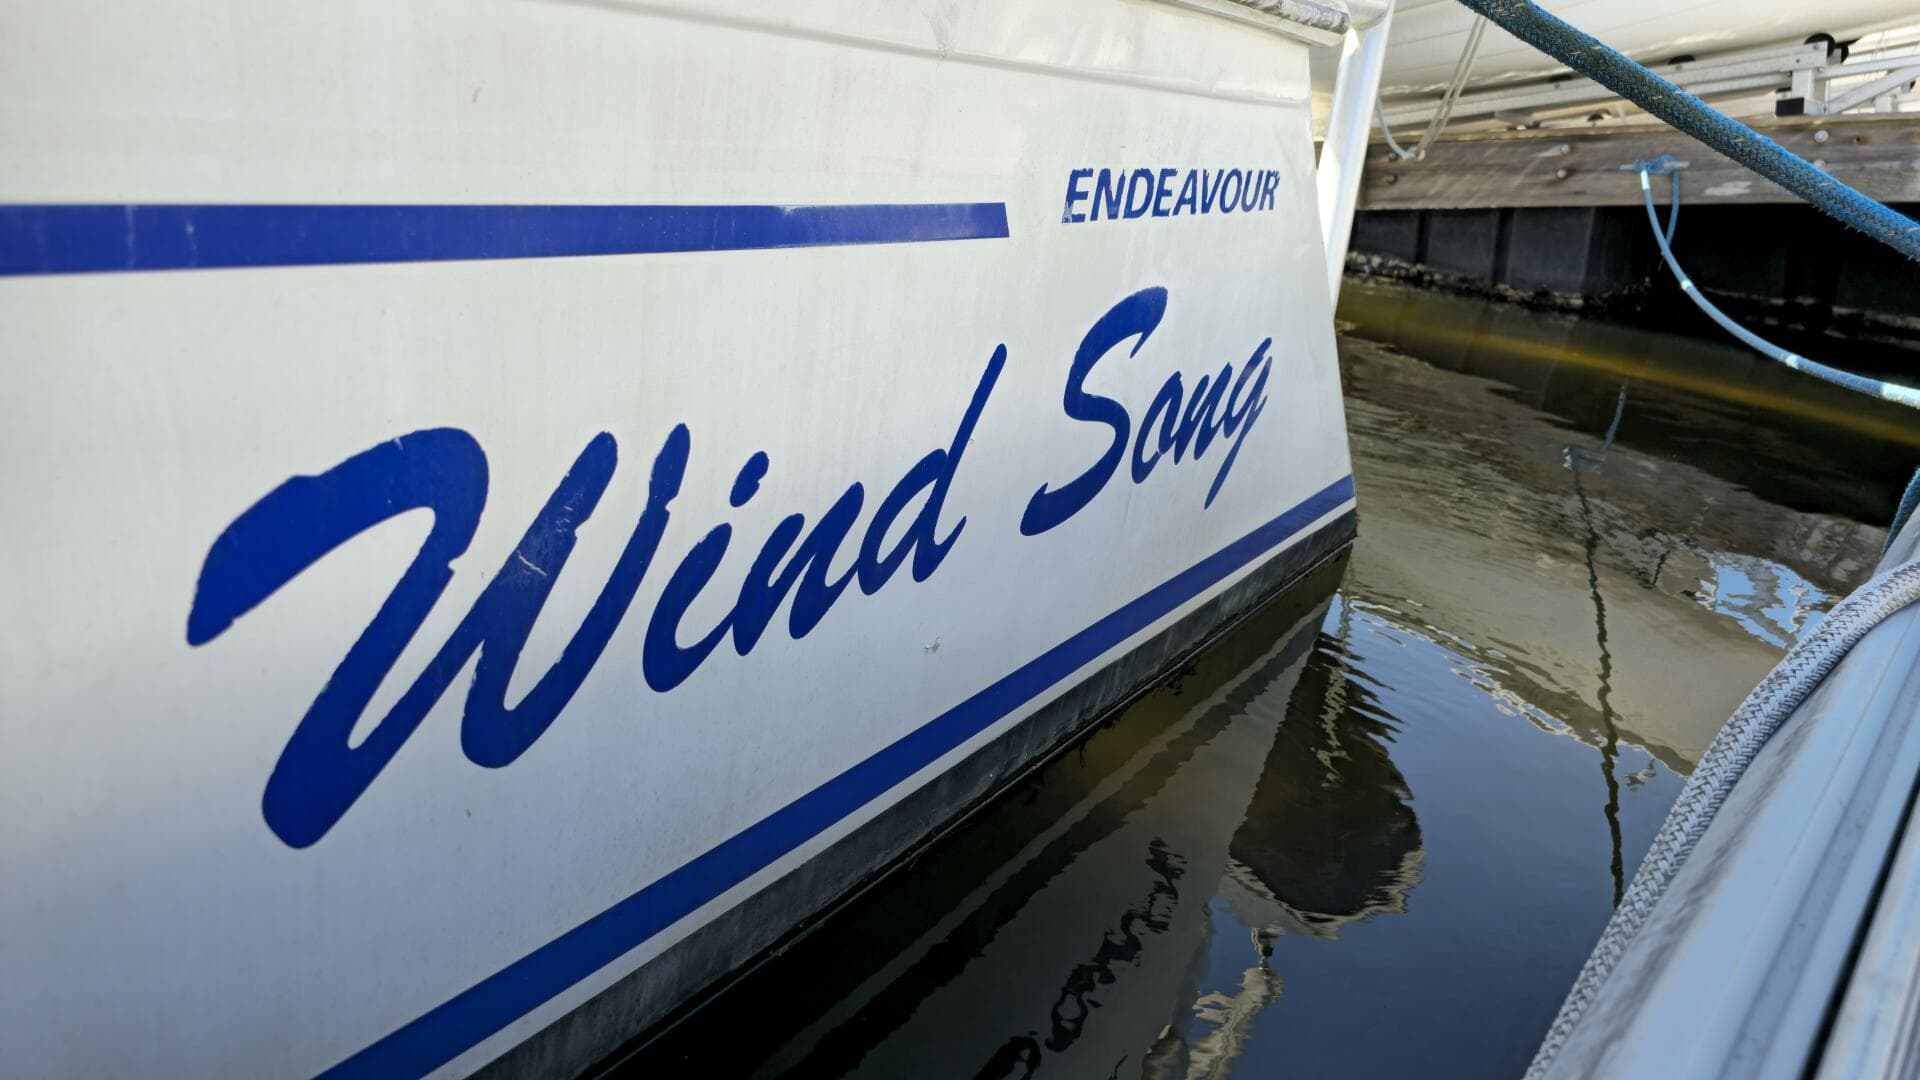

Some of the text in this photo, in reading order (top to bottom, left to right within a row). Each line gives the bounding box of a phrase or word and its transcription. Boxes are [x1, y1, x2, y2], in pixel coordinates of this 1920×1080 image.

[1062, 168, 1280, 223] ENDEAVOUR
[186, 286, 1273, 849] Wind Song
